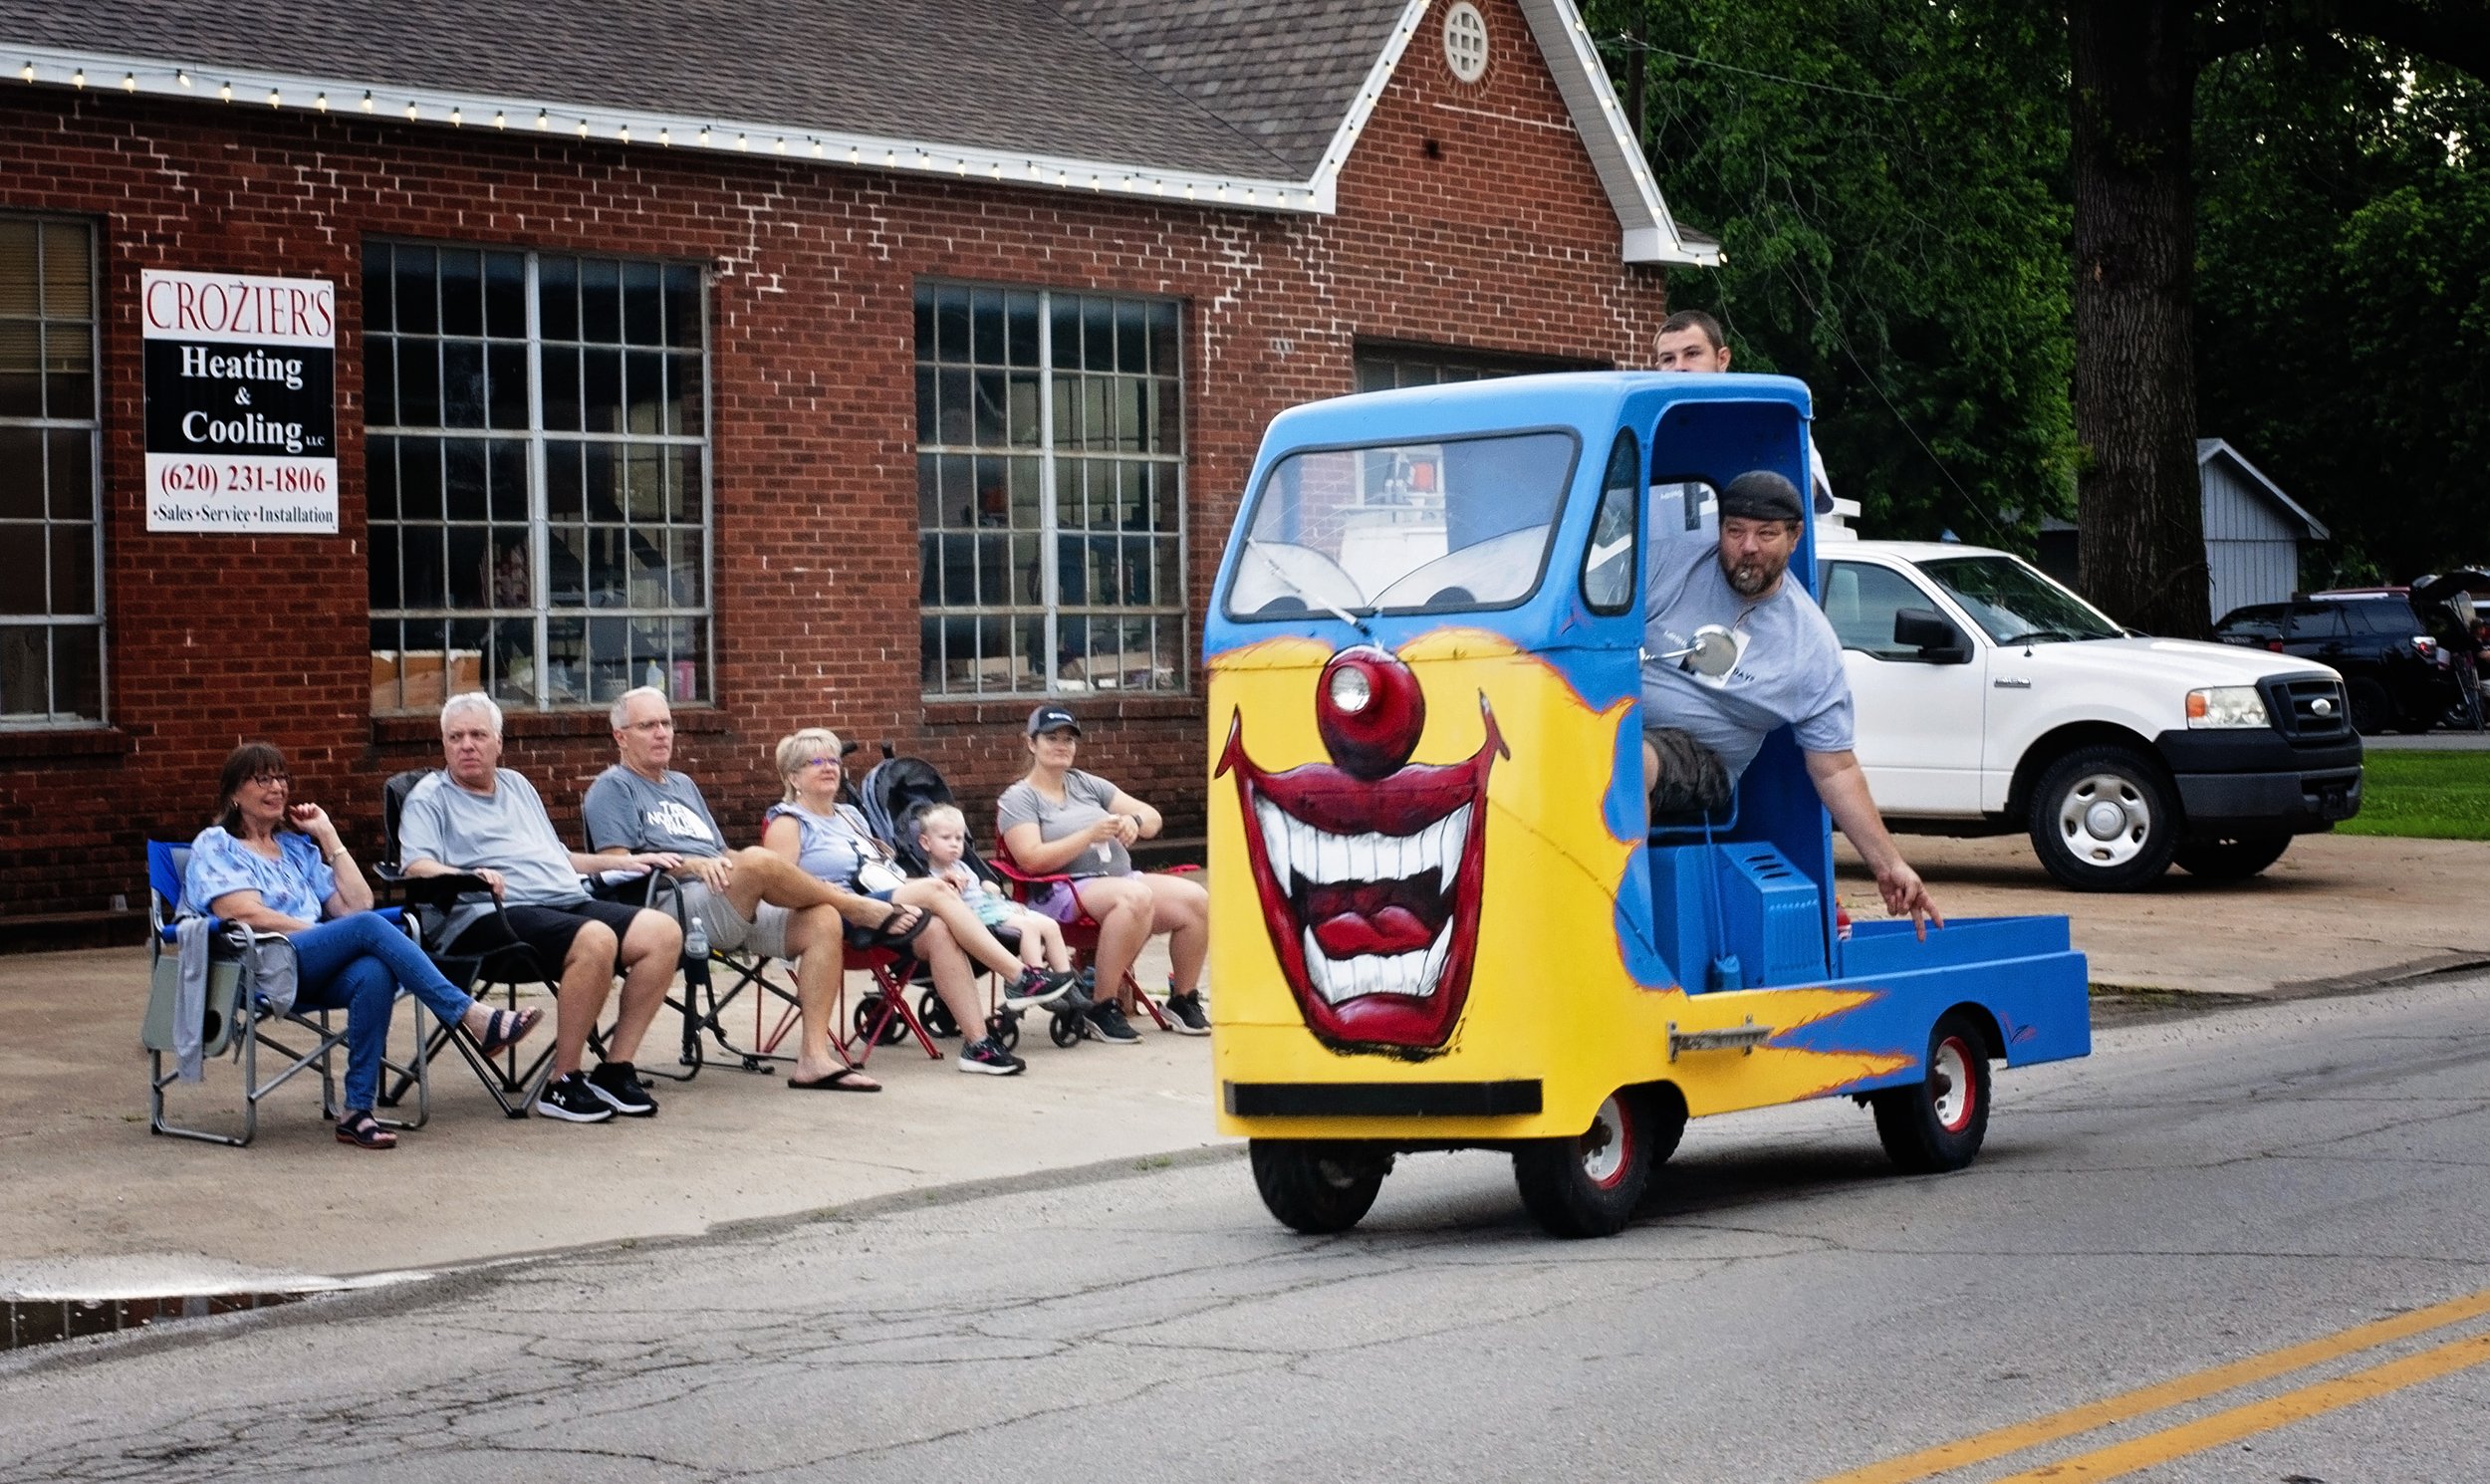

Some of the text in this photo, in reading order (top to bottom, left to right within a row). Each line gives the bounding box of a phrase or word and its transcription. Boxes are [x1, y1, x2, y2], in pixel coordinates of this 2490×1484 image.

[146, 279, 332, 338] CROZIER'S
[179, 346, 304, 390] Heating
[234, 385, 252, 405] &
[181, 410, 325, 454] Cooling LLC
[160, 462, 326, 497] (620) 231-1806
[157, 503, 334, 524] Sales Service Installation
